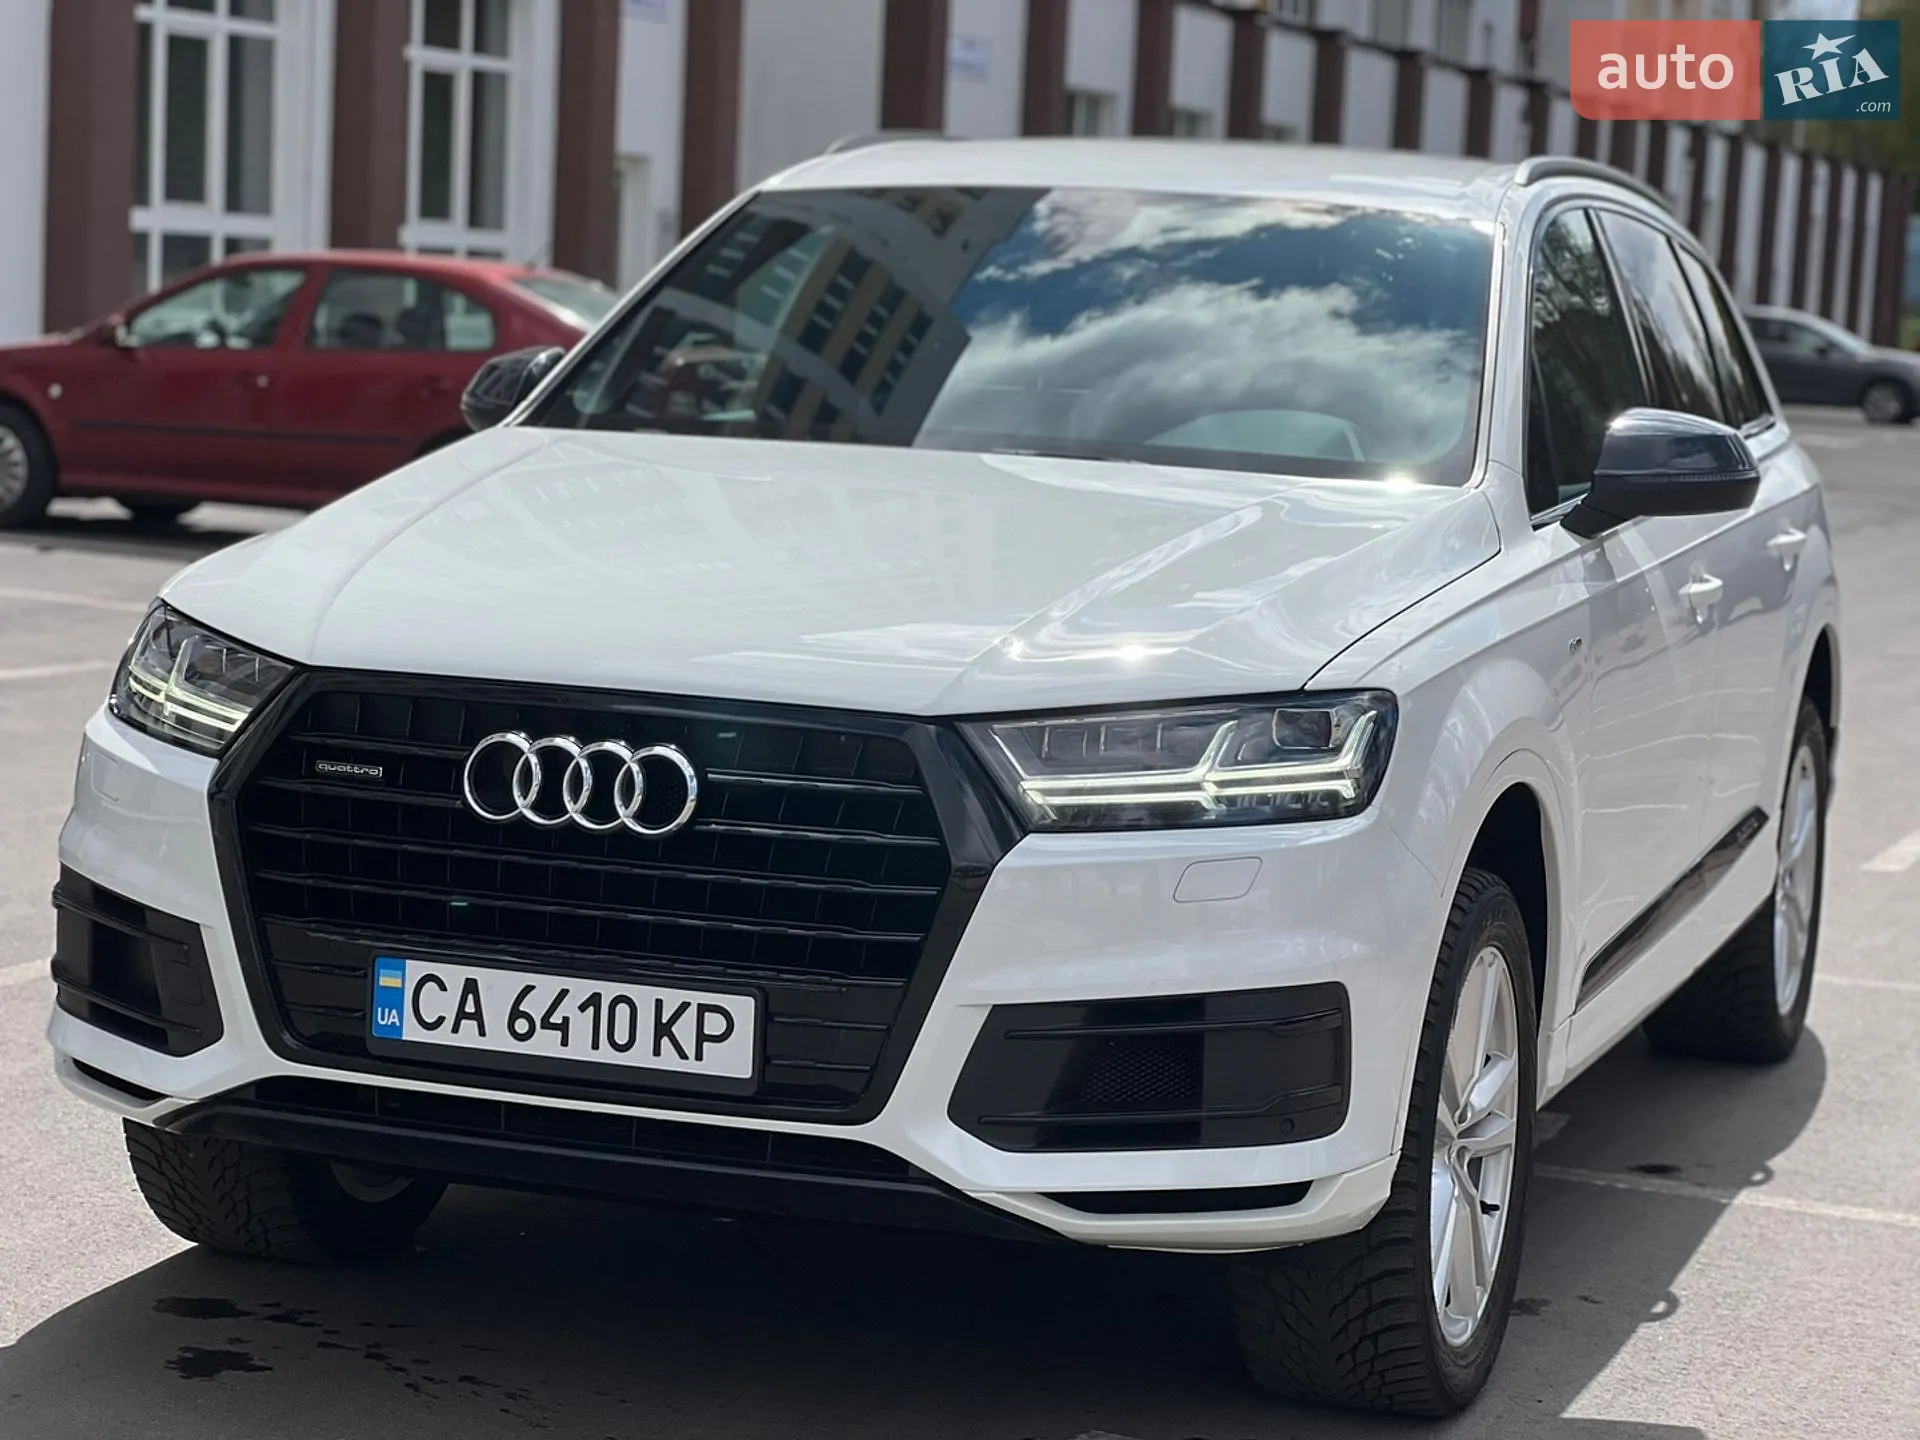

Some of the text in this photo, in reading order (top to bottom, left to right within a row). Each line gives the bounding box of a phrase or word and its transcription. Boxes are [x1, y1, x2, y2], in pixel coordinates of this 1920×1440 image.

[317, 762, 379, 776] quattro
[377, 1006, 400, 1026] UA
[411, 973, 735, 1062] CA 6410 KP
